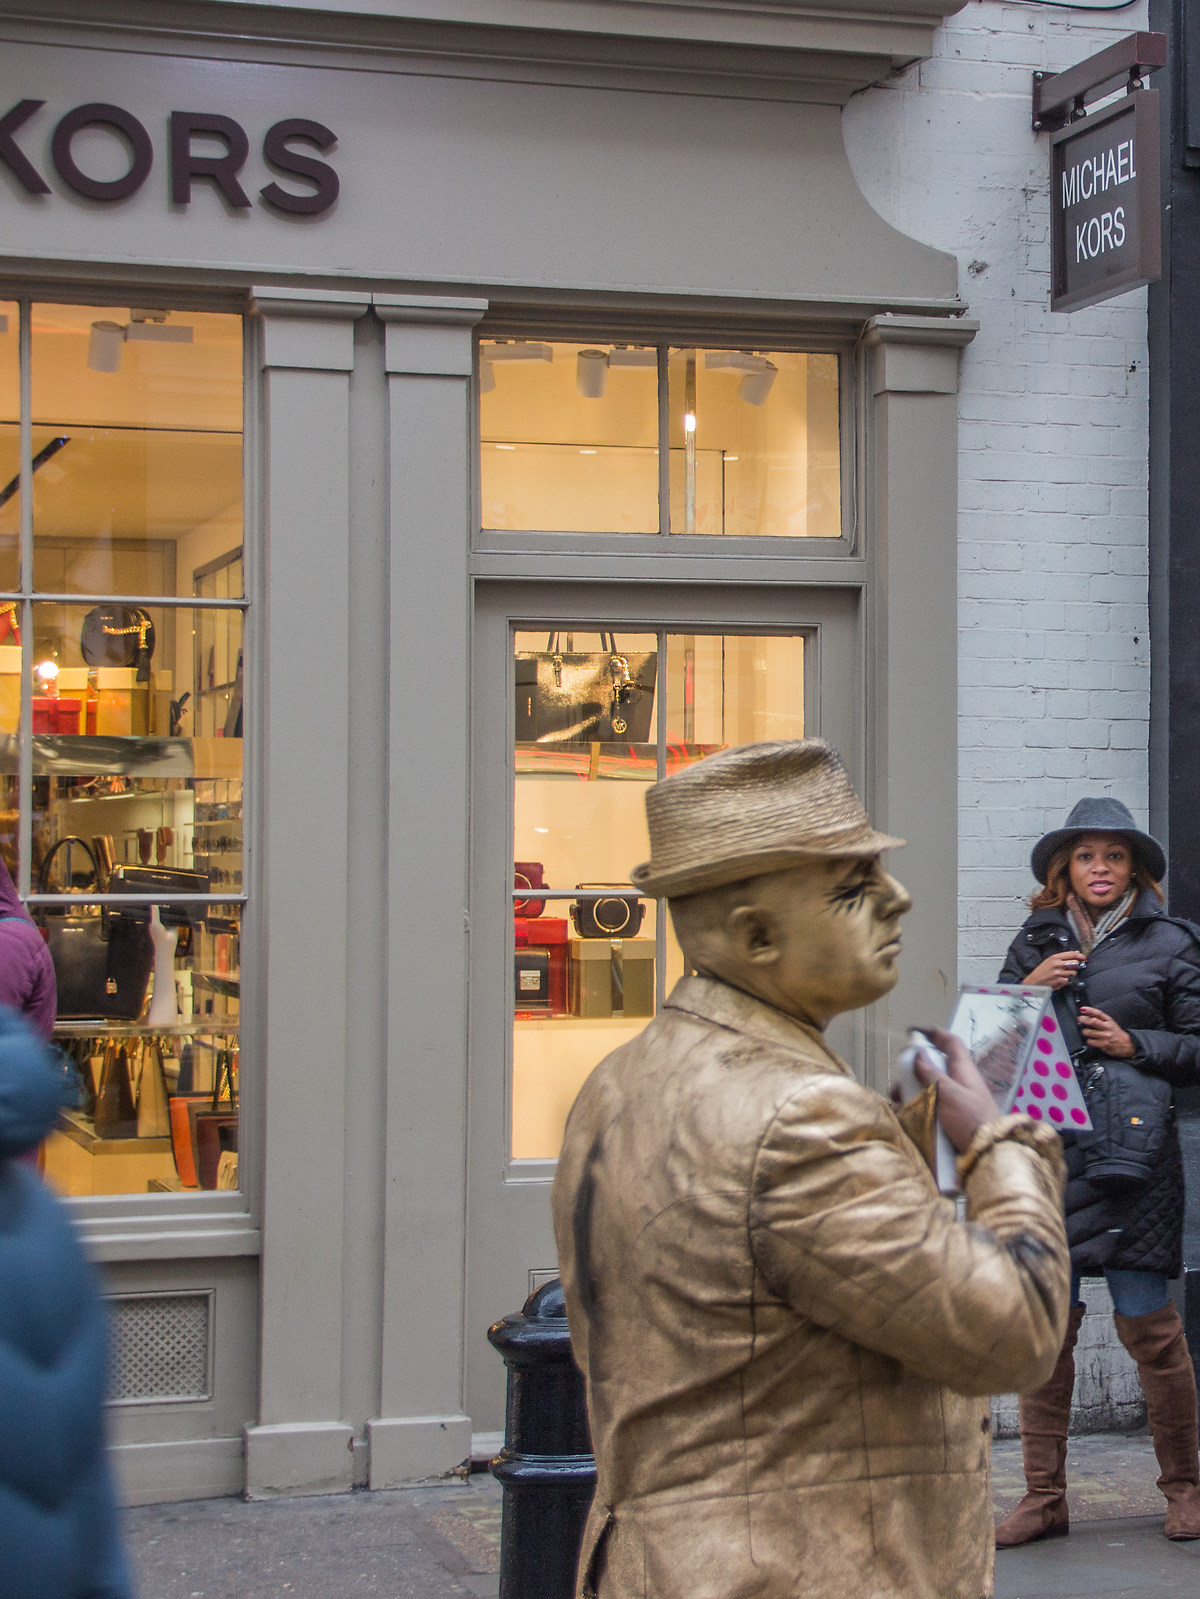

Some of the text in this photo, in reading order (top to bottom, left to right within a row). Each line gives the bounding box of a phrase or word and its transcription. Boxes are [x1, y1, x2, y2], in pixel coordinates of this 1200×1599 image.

[0, 98, 341, 215] KORS
[1061, 139, 1137, 209] MICHAEL
[1075, 206, 1126, 263] KORS
